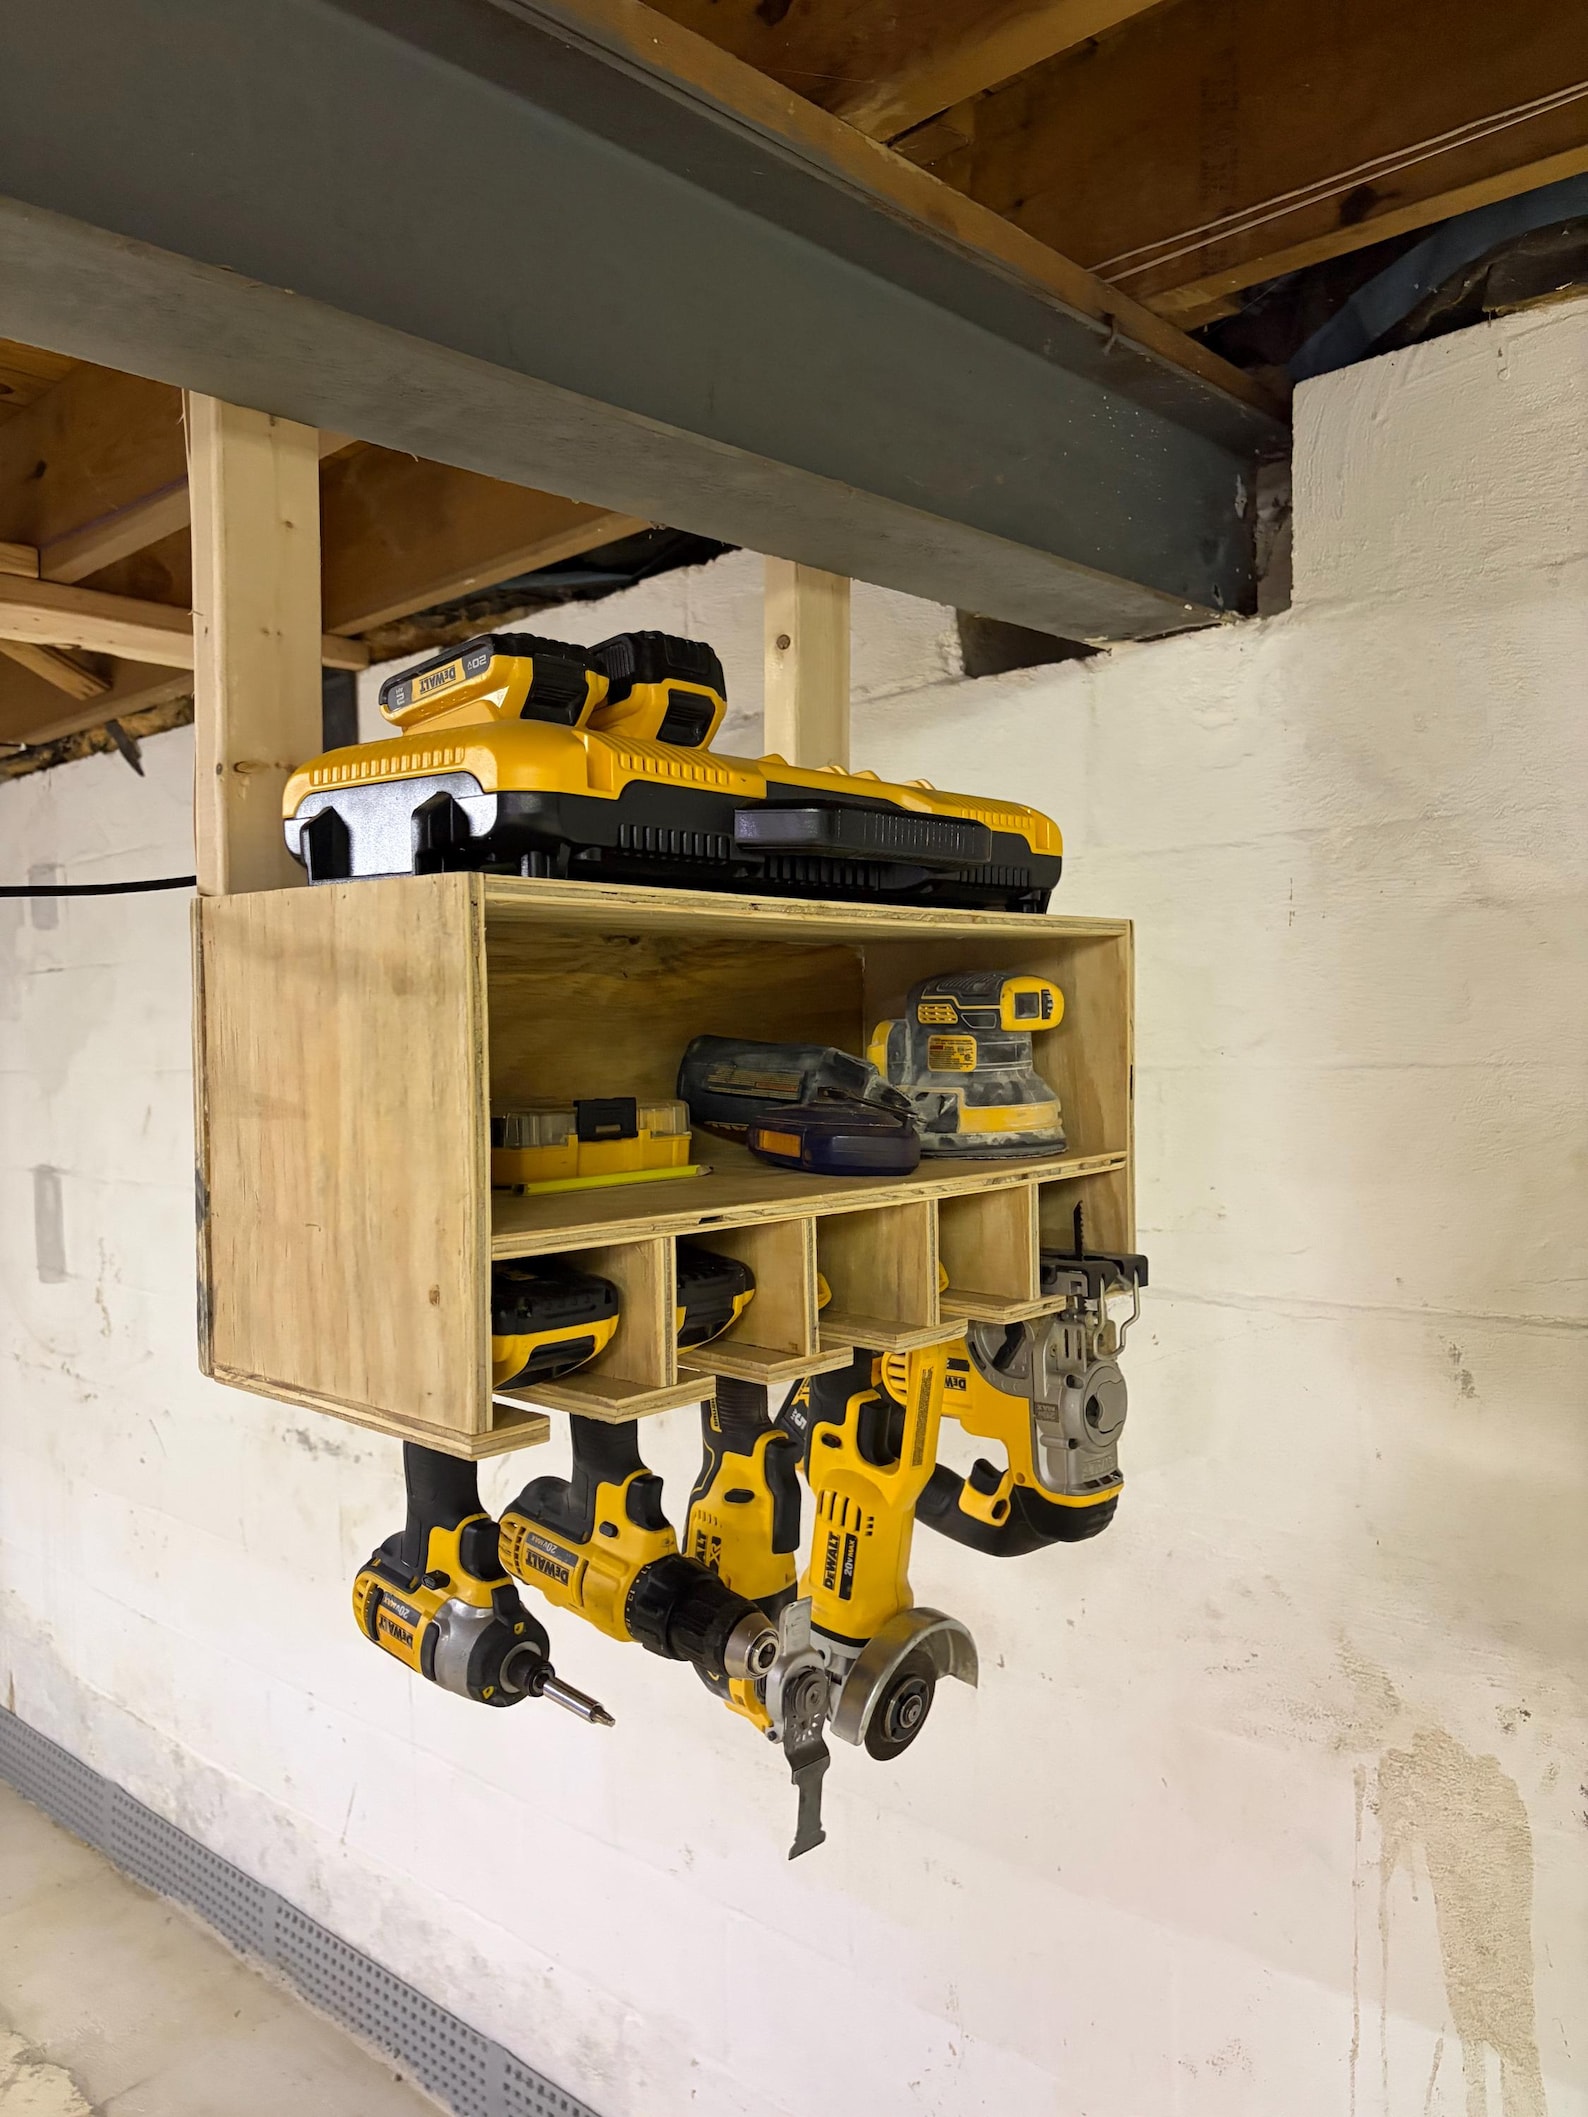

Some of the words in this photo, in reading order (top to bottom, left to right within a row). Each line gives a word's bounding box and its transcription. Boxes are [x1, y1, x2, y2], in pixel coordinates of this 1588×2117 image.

[419, 666, 456, 693] DEWALT
[525, 1549, 569, 1586] DEWALT
[822, 1531, 840, 1591] DEWALT
[379, 1614, 413, 1649] DEWALT
